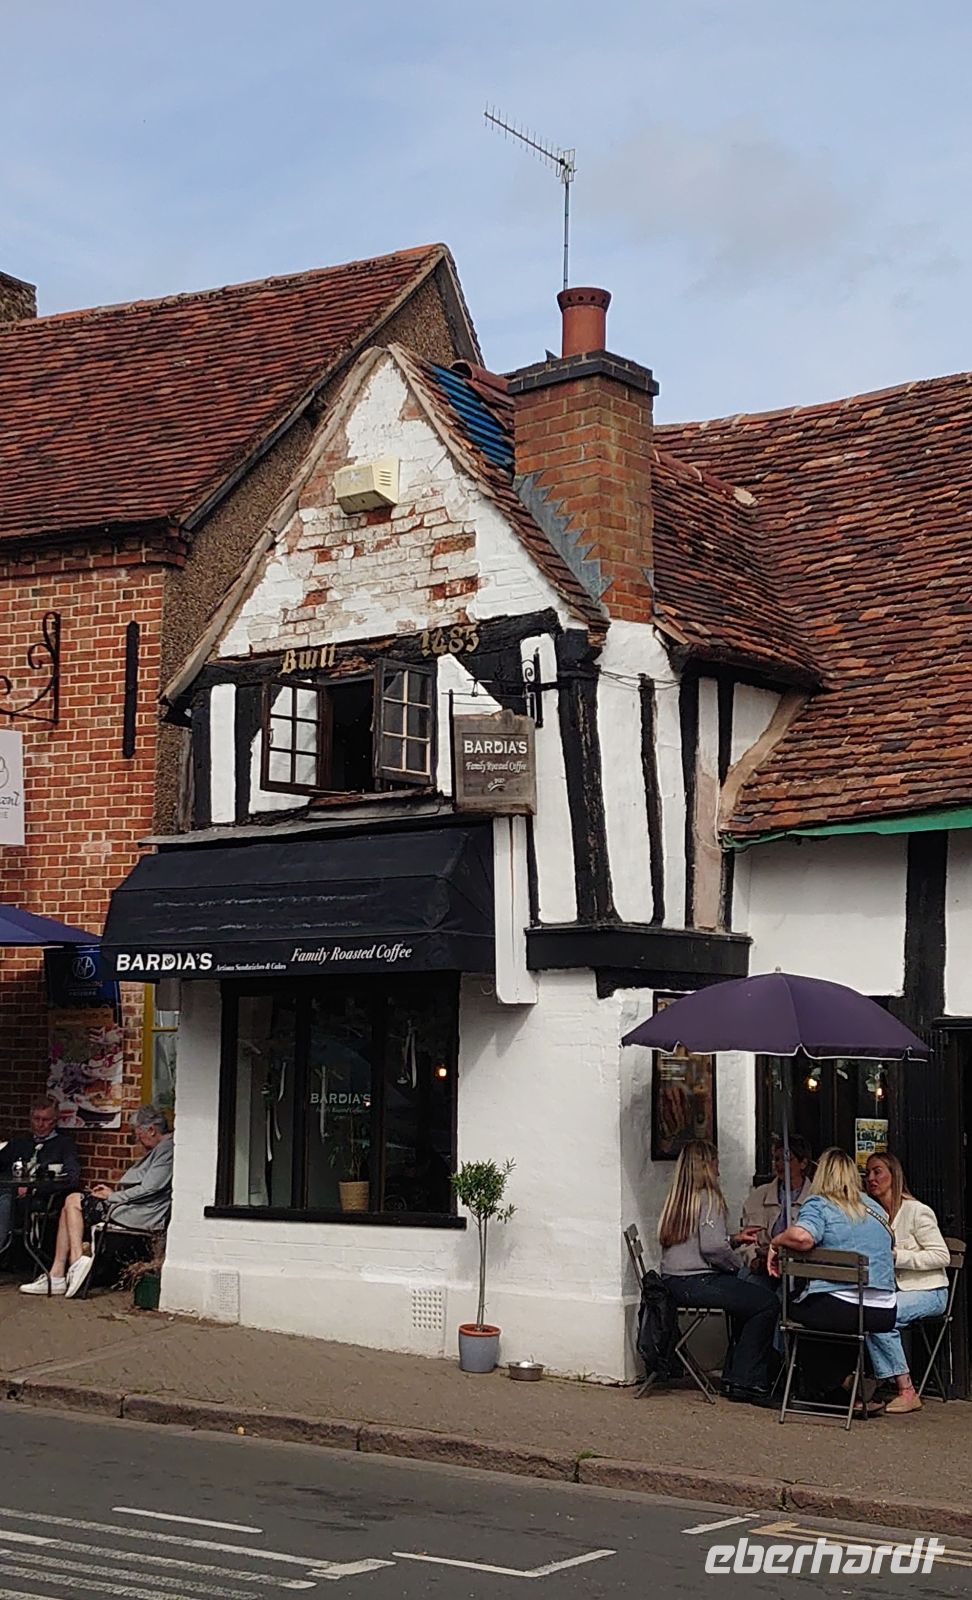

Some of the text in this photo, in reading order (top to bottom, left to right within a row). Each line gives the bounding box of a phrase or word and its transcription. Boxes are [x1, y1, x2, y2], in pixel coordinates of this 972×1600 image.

[278, 643, 337, 676] Built
[463, 740, 528, 754] BARDIA'S
[116, 952, 213, 971] BARDIA'S
[290, 943, 413, 965] Family Roasted Coffee
[310, 1092, 371, 1105] BARDIA'S
